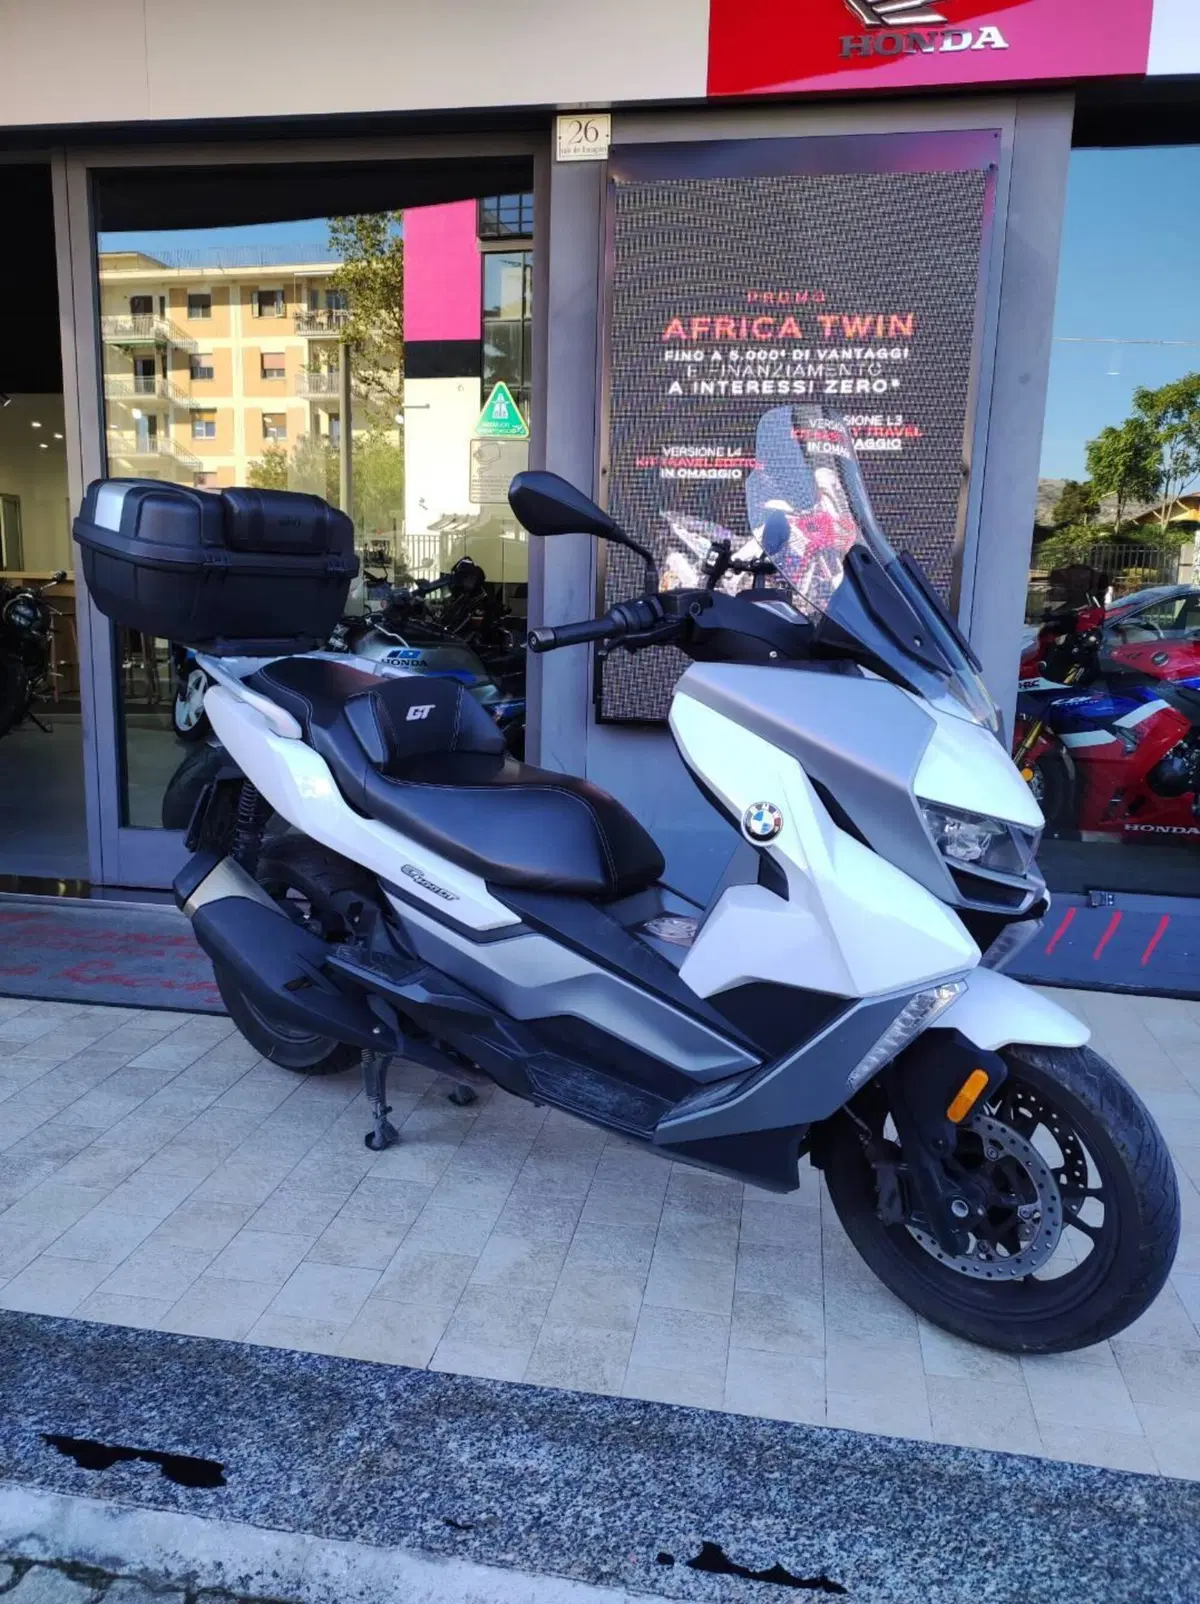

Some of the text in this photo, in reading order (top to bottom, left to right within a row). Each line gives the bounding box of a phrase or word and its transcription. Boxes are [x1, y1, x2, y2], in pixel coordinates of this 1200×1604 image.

[839, 26, 1009, 58] HONDA
[568, 118, 599, 144] 26
[747, 290, 826, 303] PROMO
[662, 312, 915, 342] AFRICA TWIN
[664, 349, 704, 361] FINO
[711, 350, 723, 360] A
[792, 349, 810, 361] DI
[817, 347, 909, 360] VANTAGGI
[668, 380, 682, 394] A
[693, 379, 814, 394] INTERESSI
[662, 446, 725, 457] VERSIONE
[660, 468, 742, 479] IN OMAGGIO
[382, 658, 428, 667] HONDA
[406, 704, 436, 721] GT
[1124, 824, 1200, 834] HONDA
